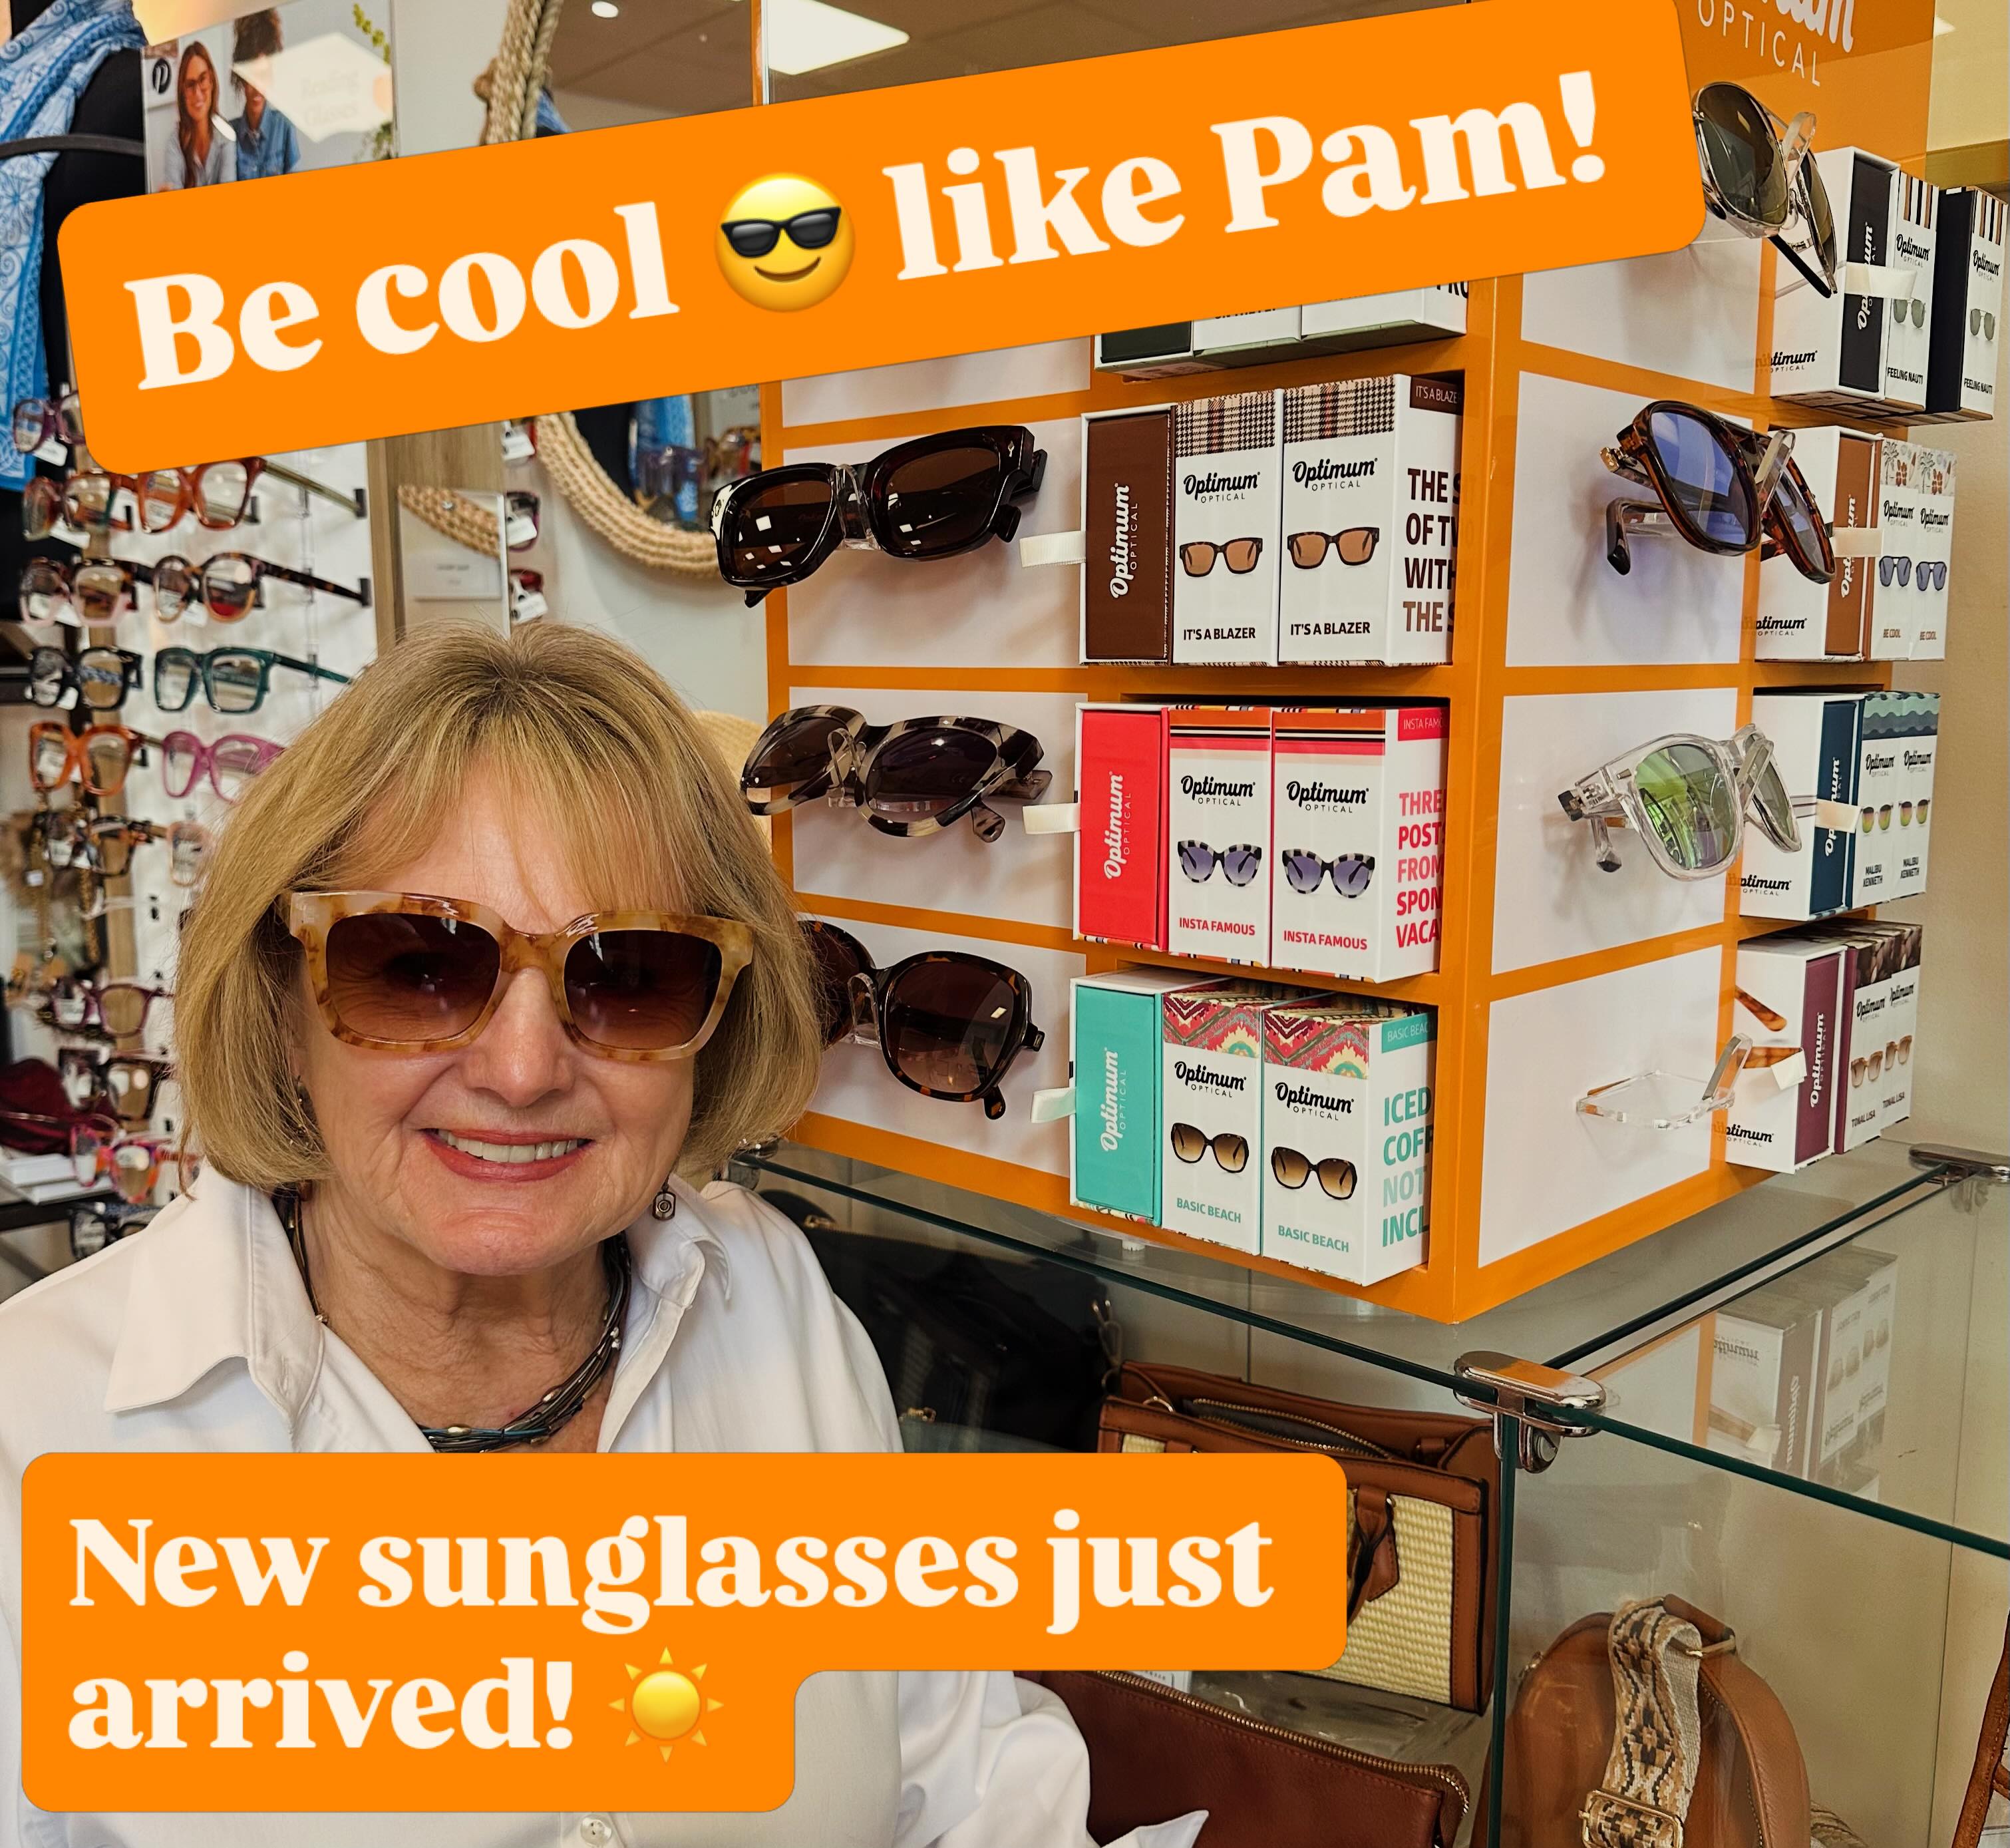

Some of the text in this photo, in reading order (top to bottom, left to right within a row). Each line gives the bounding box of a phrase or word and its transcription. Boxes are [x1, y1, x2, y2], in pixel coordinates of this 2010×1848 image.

[1697, 0, 1820, 87] OPTICAL
[1896, 234, 1930, 261] Optimum
[1973, 250, 1999, 276] Optimum
[1887, 367, 1924, 385] FEELING NAUTI
[1429, 388, 1435, 399] A
[1436, 389, 1462, 404] BLAZE
[1184, 472, 1259, 500] Optimum
[1292, 458, 1376, 488] Optimum
[1311, 480, 1361, 491] OPTICAL
[1407, 468, 1448, 503] THE
[1200, 492, 1245, 504] OPTICAL
[1884, 500, 1914, 522] Optimum
[1406, 512, 1434, 546] OF
[1920, 508, 1949, 529] Optimum
[1110, 485, 1134, 598] Optimum
[1290, 622, 1371, 636] IT'S A BLAZER
[1403, 601, 1443, 632] THE
[1183, 628, 1256, 641] IT'S A BLAZER
[1404, 718, 1423, 730] INSTA
[1181, 775, 1254, 800] Optimum
[1287, 781, 1368, 807] Optimum
[1198, 797, 1241, 807] OPTICAL
[1305, 804, 1353, 813] OPTICAL
[1104, 773, 1126, 879] Optimum
[1179, 917, 1256, 936] INSTA FAMOUS
[1396, 917, 1441, 948] VACA
[1283, 930, 1368, 950] INSTA FAMOUS
[1387, 1021, 1432, 1041] BASIC BEAC
[1810, 1012, 1824, 1107] Optimum
[1174, 1061, 1245, 1091] Optimum
[1100, 1049, 1123, 1151] Optimum
[1191, 1083, 1232, 1098] OPTICAL
[1275, 1082, 1353, 1113] Optimum
[1293, 1106, 1339, 1121] OPTICAL
[1385, 1086, 1432, 1127] ICED
[1383, 1166, 1428, 1208] NOT
[1176, 1198, 1242, 1223] BASIC BEACH
[1278, 1225, 1349, 1252] BASIC BEACH
